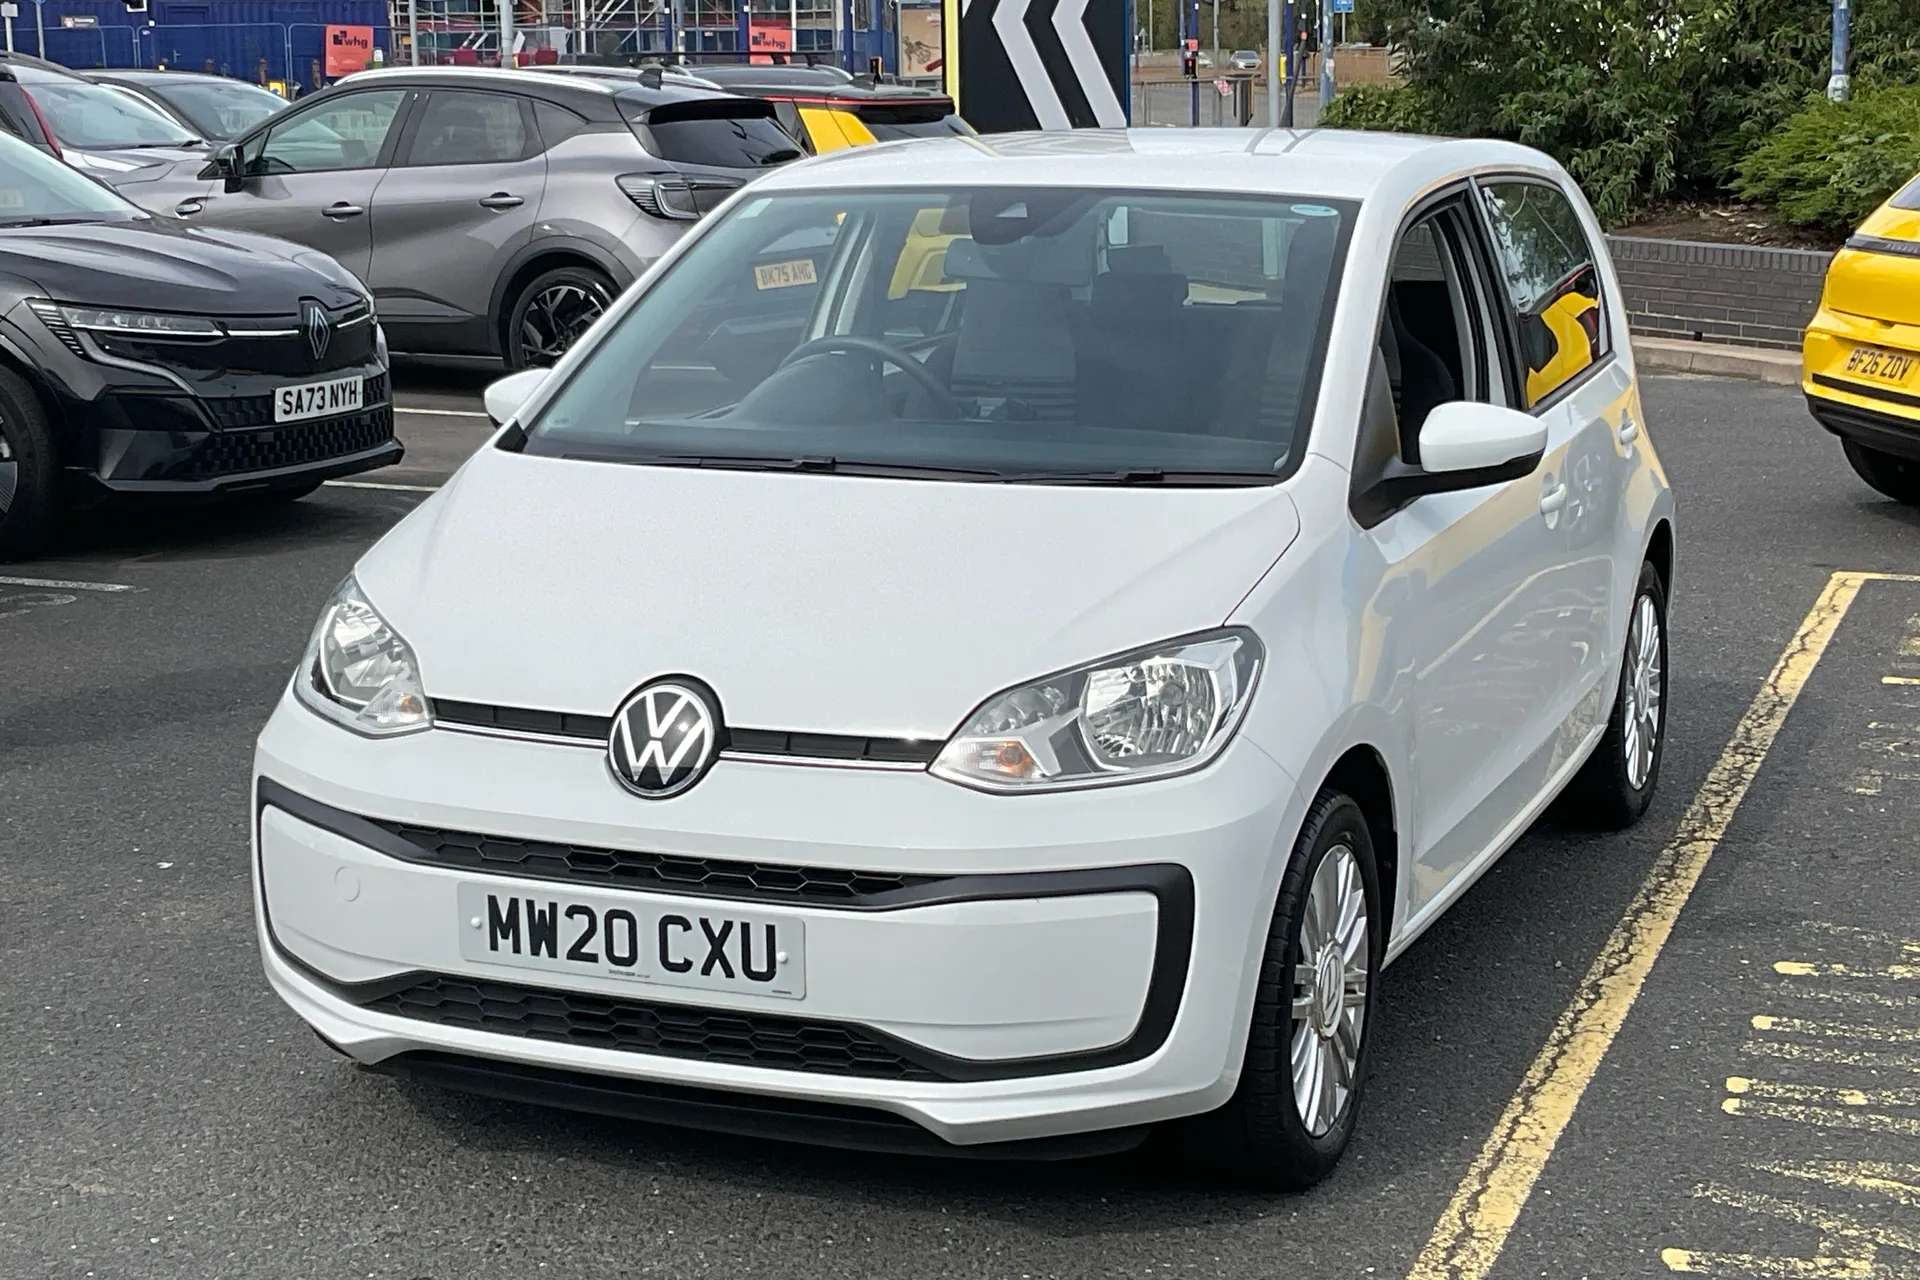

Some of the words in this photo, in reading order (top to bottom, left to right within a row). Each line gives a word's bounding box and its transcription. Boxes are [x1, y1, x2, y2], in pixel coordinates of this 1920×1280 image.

[344, 35, 368, 49] whg
[1846, 349, 1884, 375] BF26
[282, 385, 326, 415] SA73
[329, 379, 358, 408] NYH
[486, 893, 639, 967] MW20
[658, 913, 778, 983] CXU
